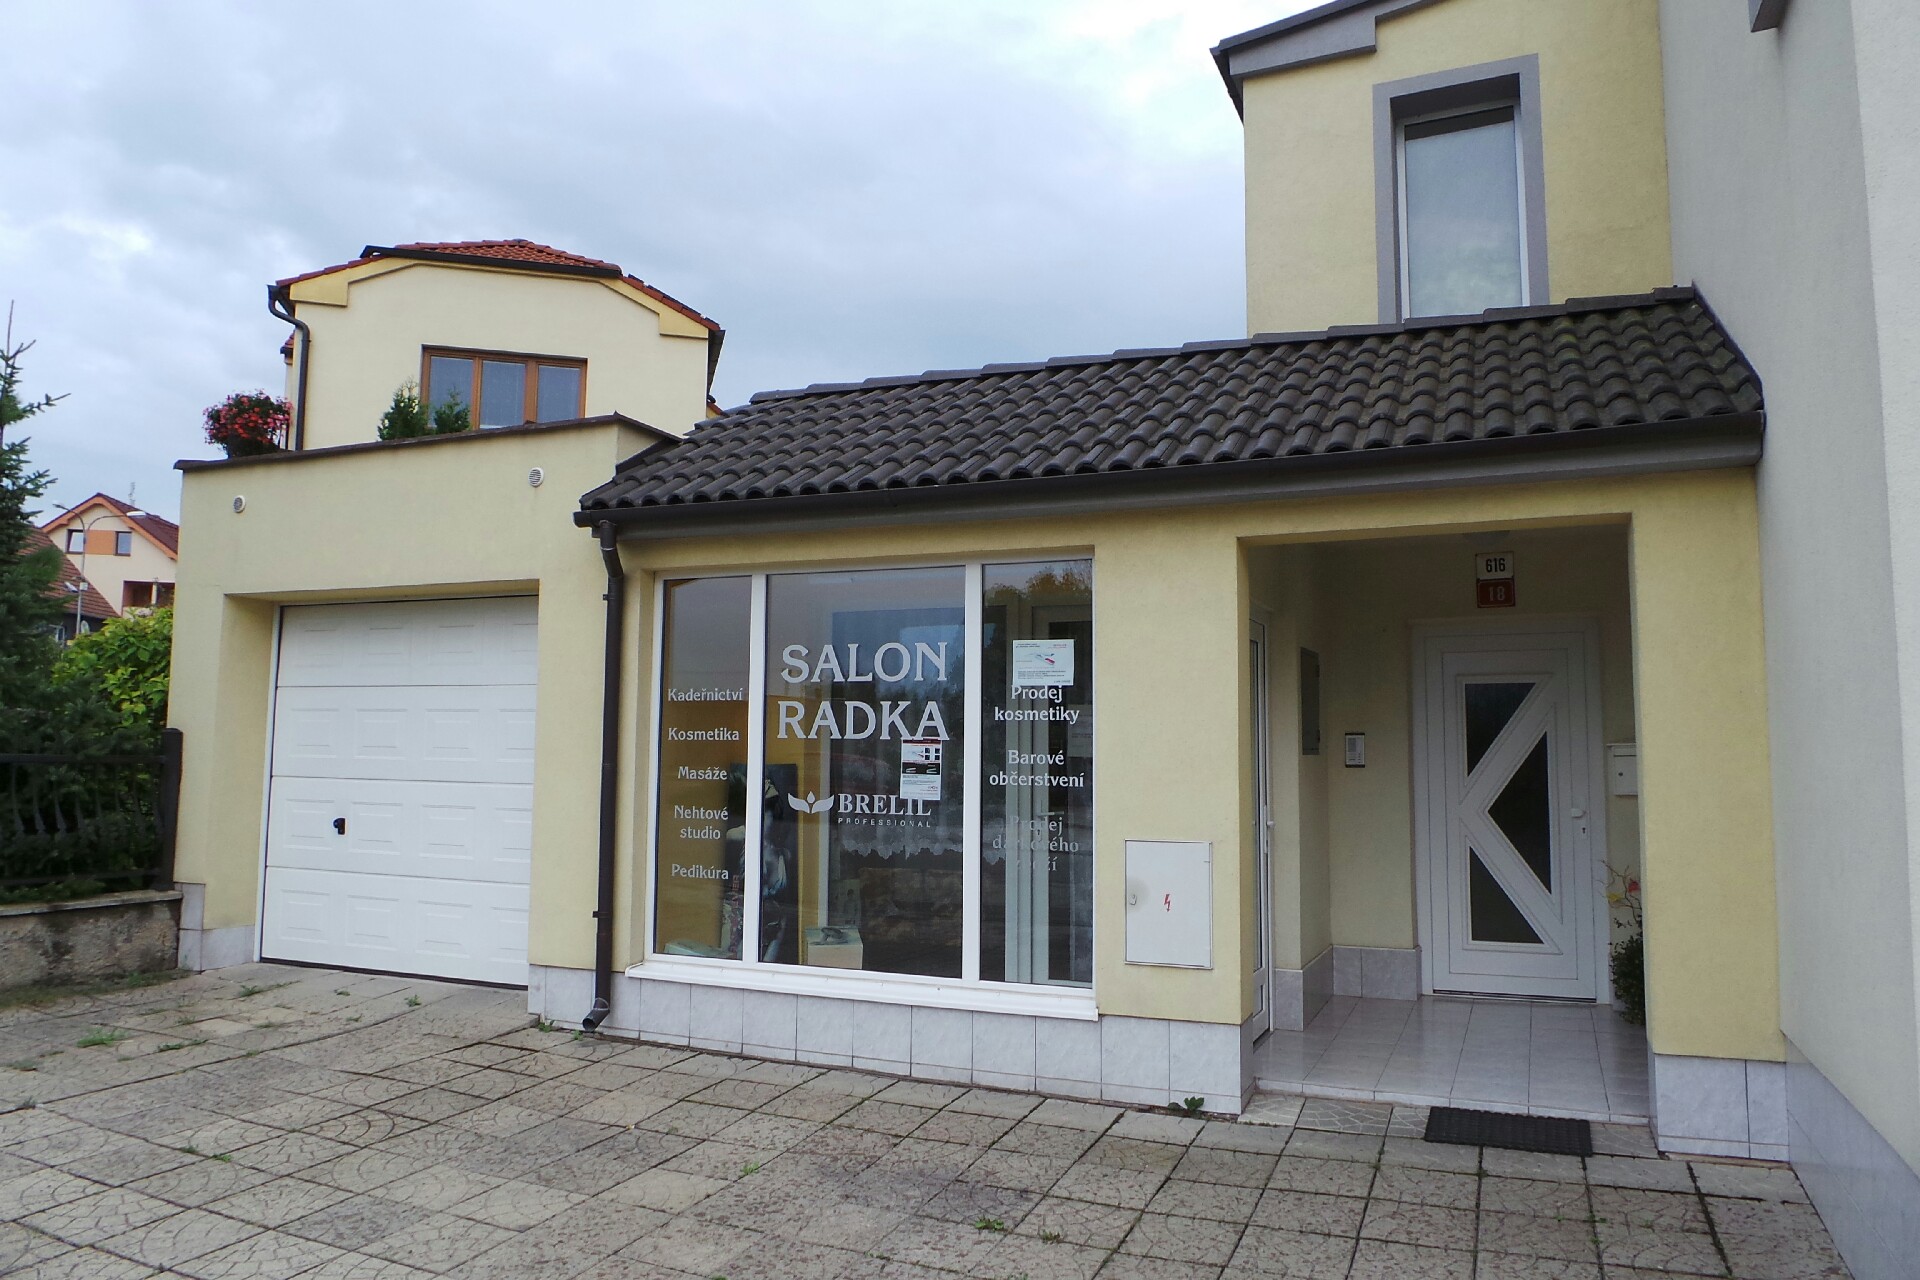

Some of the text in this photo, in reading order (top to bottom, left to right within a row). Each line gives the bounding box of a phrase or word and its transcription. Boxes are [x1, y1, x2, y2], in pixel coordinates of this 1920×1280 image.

[1485, 557, 1506, 573] 616
[1488, 586, 1506, 602] 18
[780, 641, 948, 684] SALON
[667, 687, 743, 702] Kadeřnictví
[1011, 685, 1064, 702] Prodej
[777, 700, 950, 741] RADKA
[994, 706, 1080, 725] kosmetiky
[667, 727, 740, 742] Kosmetika
[1007, 749, 1065, 765] Barové
[677, 765, 728, 781] Masáže
[989, 770, 1085, 788] občerstvení
[673, 804, 729, 821] Nehtové
[837, 793, 932, 816] BRELIL
[837, 817, 932, 828] PROFESSIONAL
[679, 825, 721, 840] studio
[671, 862, 730, 880] Pedikúra
